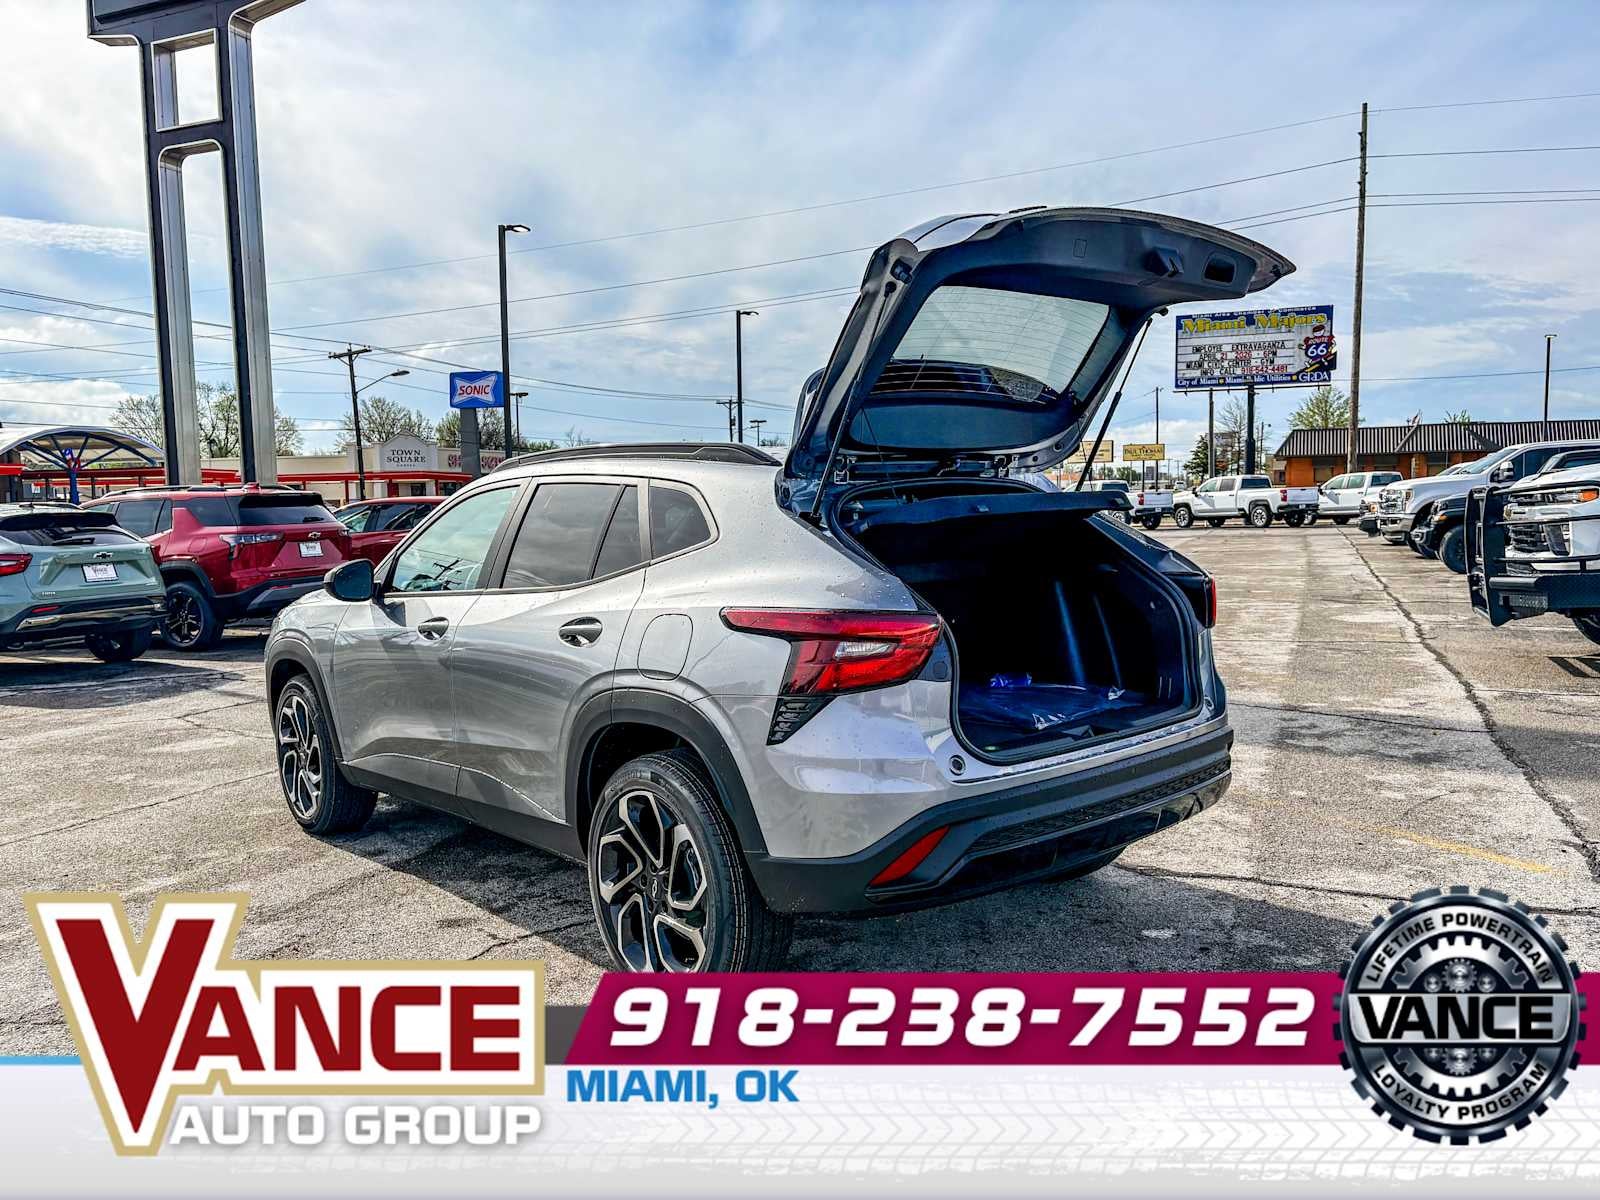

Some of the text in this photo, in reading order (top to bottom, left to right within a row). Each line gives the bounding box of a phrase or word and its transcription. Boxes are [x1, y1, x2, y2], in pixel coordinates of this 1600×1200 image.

[1181, 313, 1327, 334] Miami Majors
[1192, 341, 1286, 353] EMPLOYEE EXTRAVAGANZA
[1307, 343, 1327, 357] 66
[1199, 353, 1217, 361] APRIL
[1220, 352, 1228, 360] 21
[1263, 350, 1278, 358] 6PM
[1207, 360, 1225, 368] CIVIC
[1227, 358, 1252, 367] CENTER
[1260, 358, 1275, 366] GYM
[1219, 367, 1237, 375] CALL
[1177, 378, 1190, 387] City
[1199, 377, 1219, 385] Miami
[1266, 373, 1291, 382] Utilities
[1298, 371, 1329, 382] GRDA
[459, 384, 491, 396] SONIC
